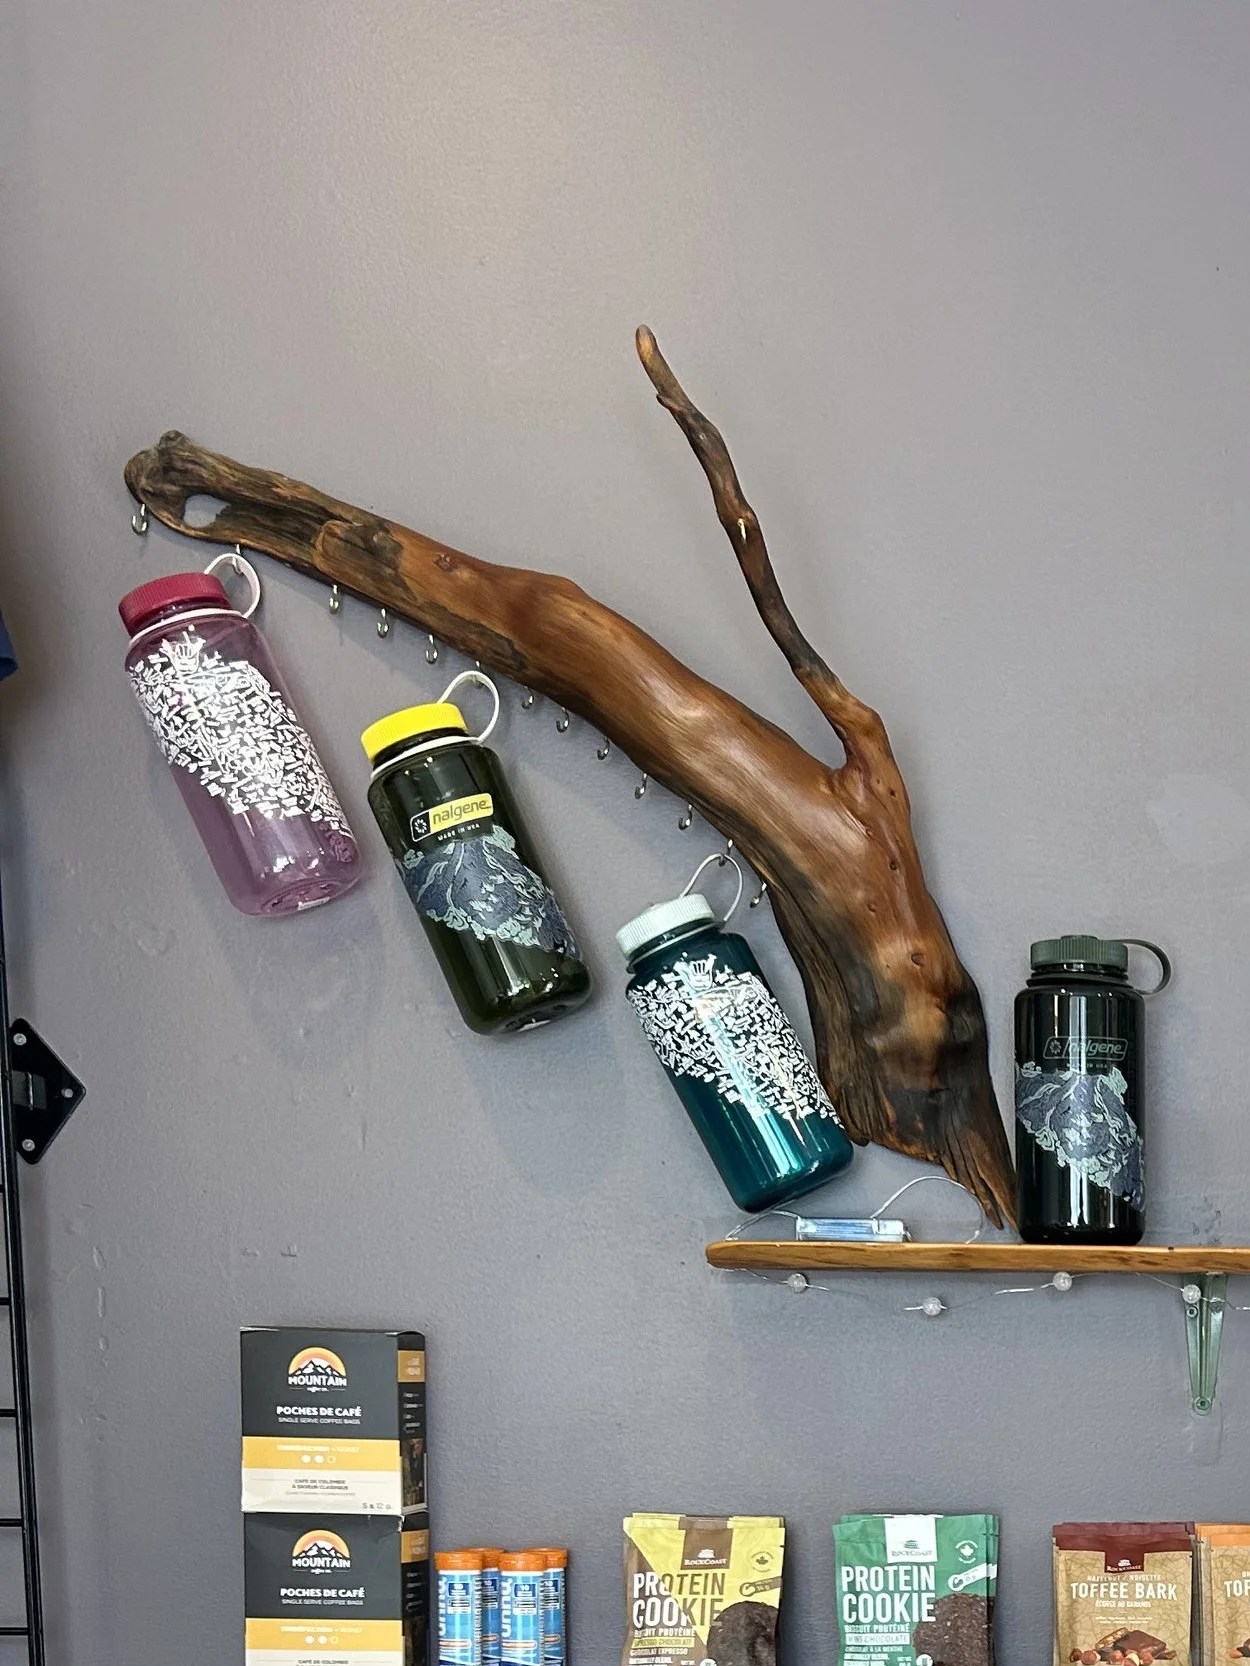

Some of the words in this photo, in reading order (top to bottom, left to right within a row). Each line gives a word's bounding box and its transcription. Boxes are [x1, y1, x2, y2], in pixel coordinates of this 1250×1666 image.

[433, 800, 491, 825] nalgene
[288, 1375, 347, 1386] MOUNTAIN
[277, 1406, 318, 1416] POCHES
[320, 1408, 333, 1416] DE
[335, 1406, 361, 1416] CAFÉ
[292, 1557, 350, 1567] MOUNTAIN
[633, 1572, 726, 1598] PROTEIN
[841, 1566, 935, 1591] PROTEIN
[280, 1588, 321, 1597] POCHES
[323, 1589, 338, 1597] DE
[338, 1587, 365, 1597] CAFÉ
[1071, 1583, 1129, 1599] TOFFEE
[1135, 1583, 1177, 1600] BARK
[633, 1598, 725, 1629] COOKIE
[843, 1593, 936, 1623] COOKIE
